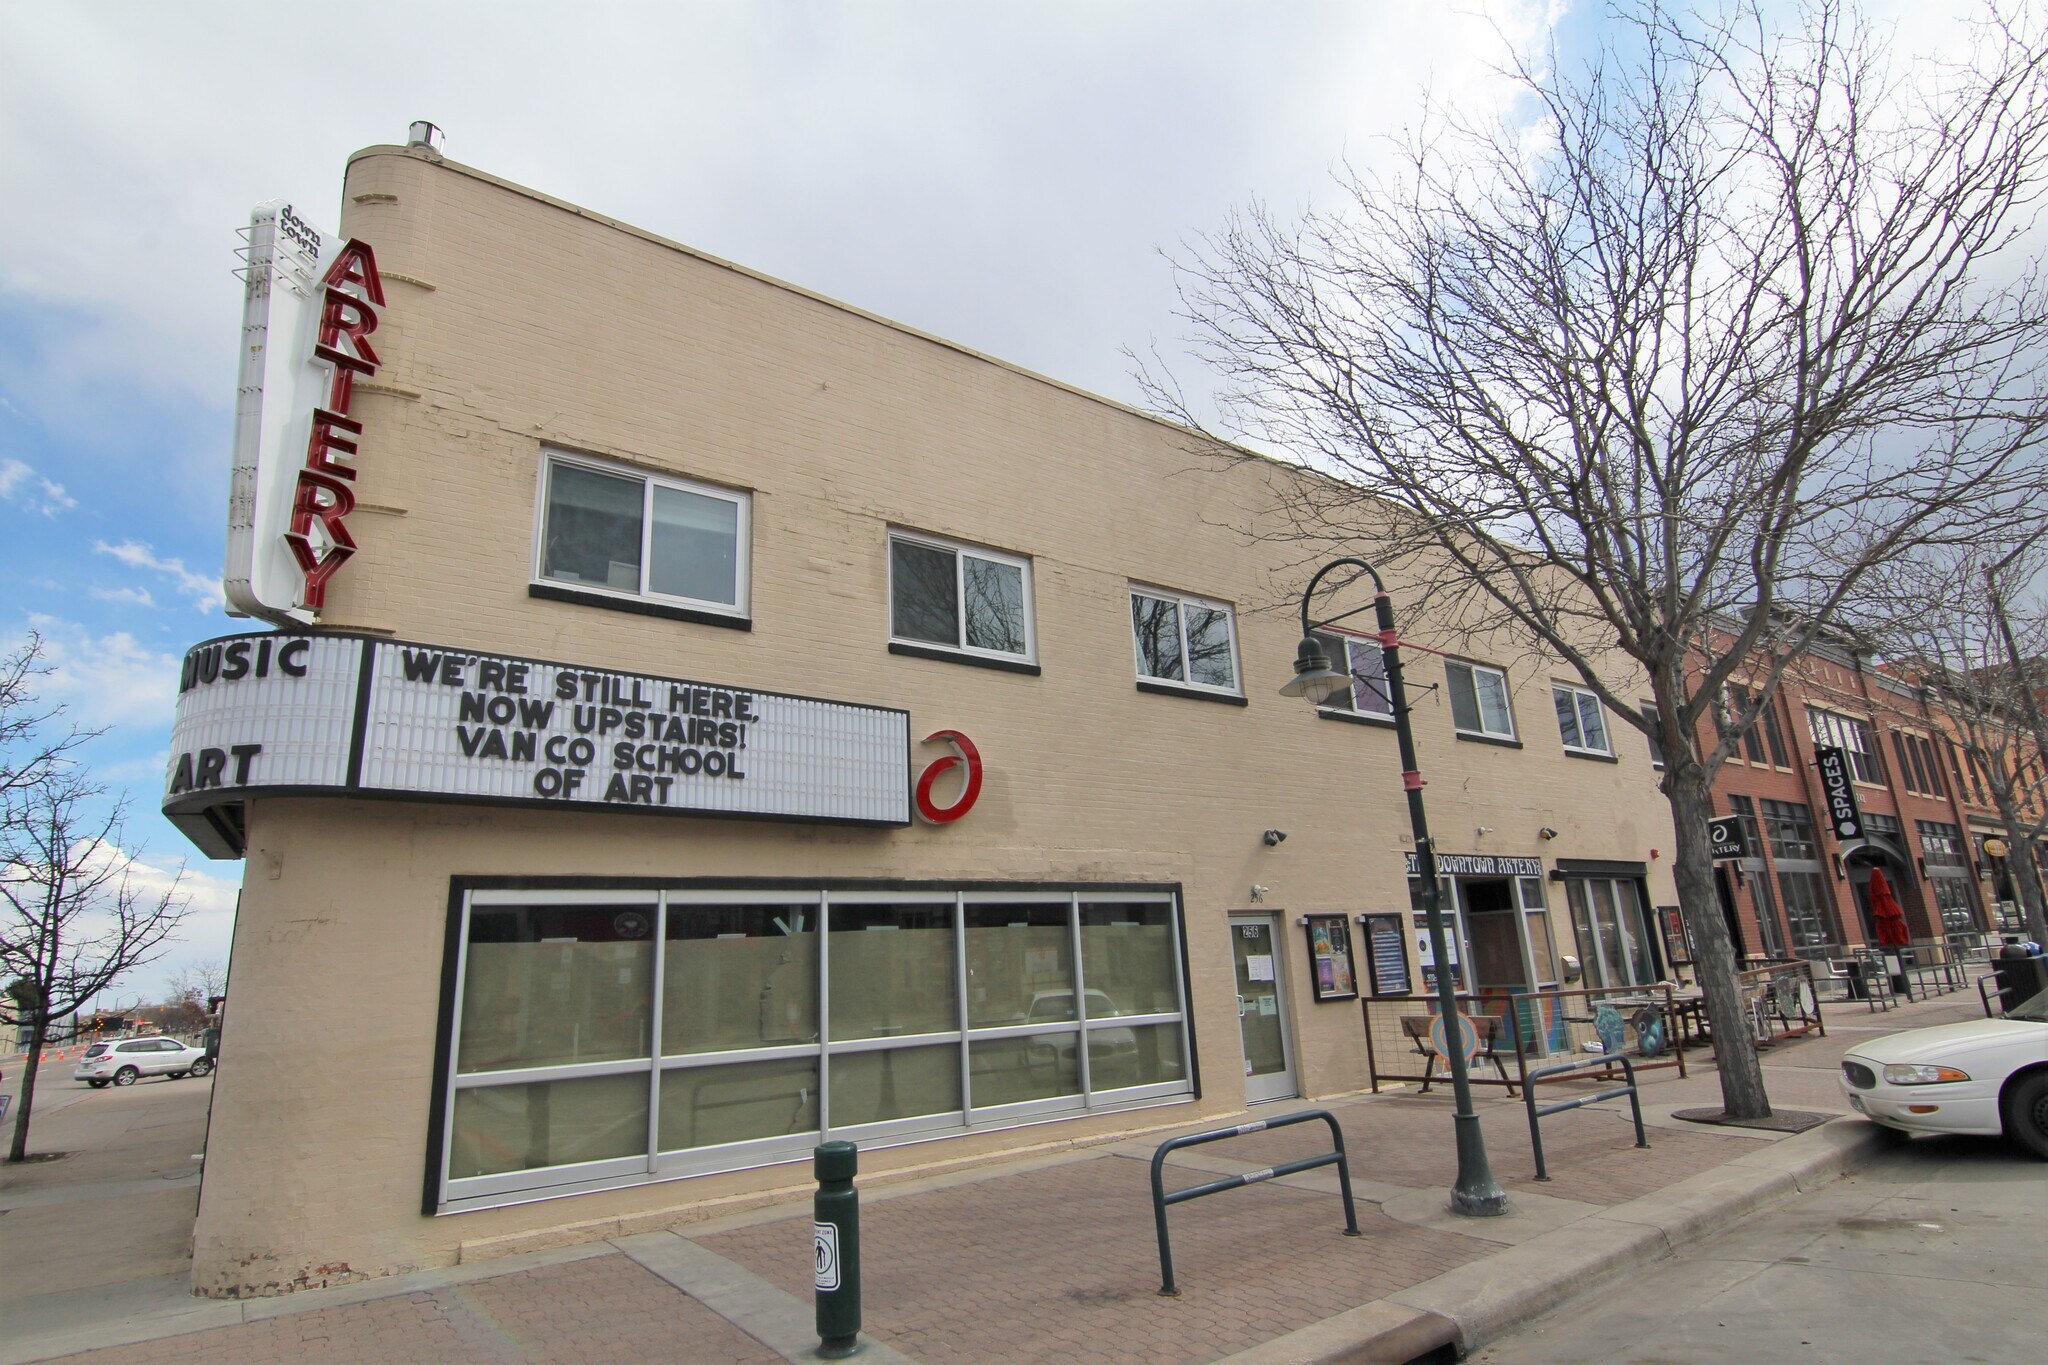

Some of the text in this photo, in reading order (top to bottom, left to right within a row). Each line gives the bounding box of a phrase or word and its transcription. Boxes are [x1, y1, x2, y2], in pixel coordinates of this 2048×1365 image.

[280, 218, 319, 259] town
[281, 204, 321, 247] down
[283, 237, 386, 608] ARTERY
[180, 639, 310, 693] MUSIC
[403, 650, 760, 723] WE'RE STILL HERE,
[459, 691, 746, 749] NOW UPSTAIRS!
[169, 744, 262, 793] ART
[613, 741, 745, 779] SCHOOL
[534, 767, 674, 804] OF ART
[1437, 855, 1495, 873] DOWNTOWN
[1250, 893, 1264, 904] 256
[1243, 926, 1259, 938] 256
